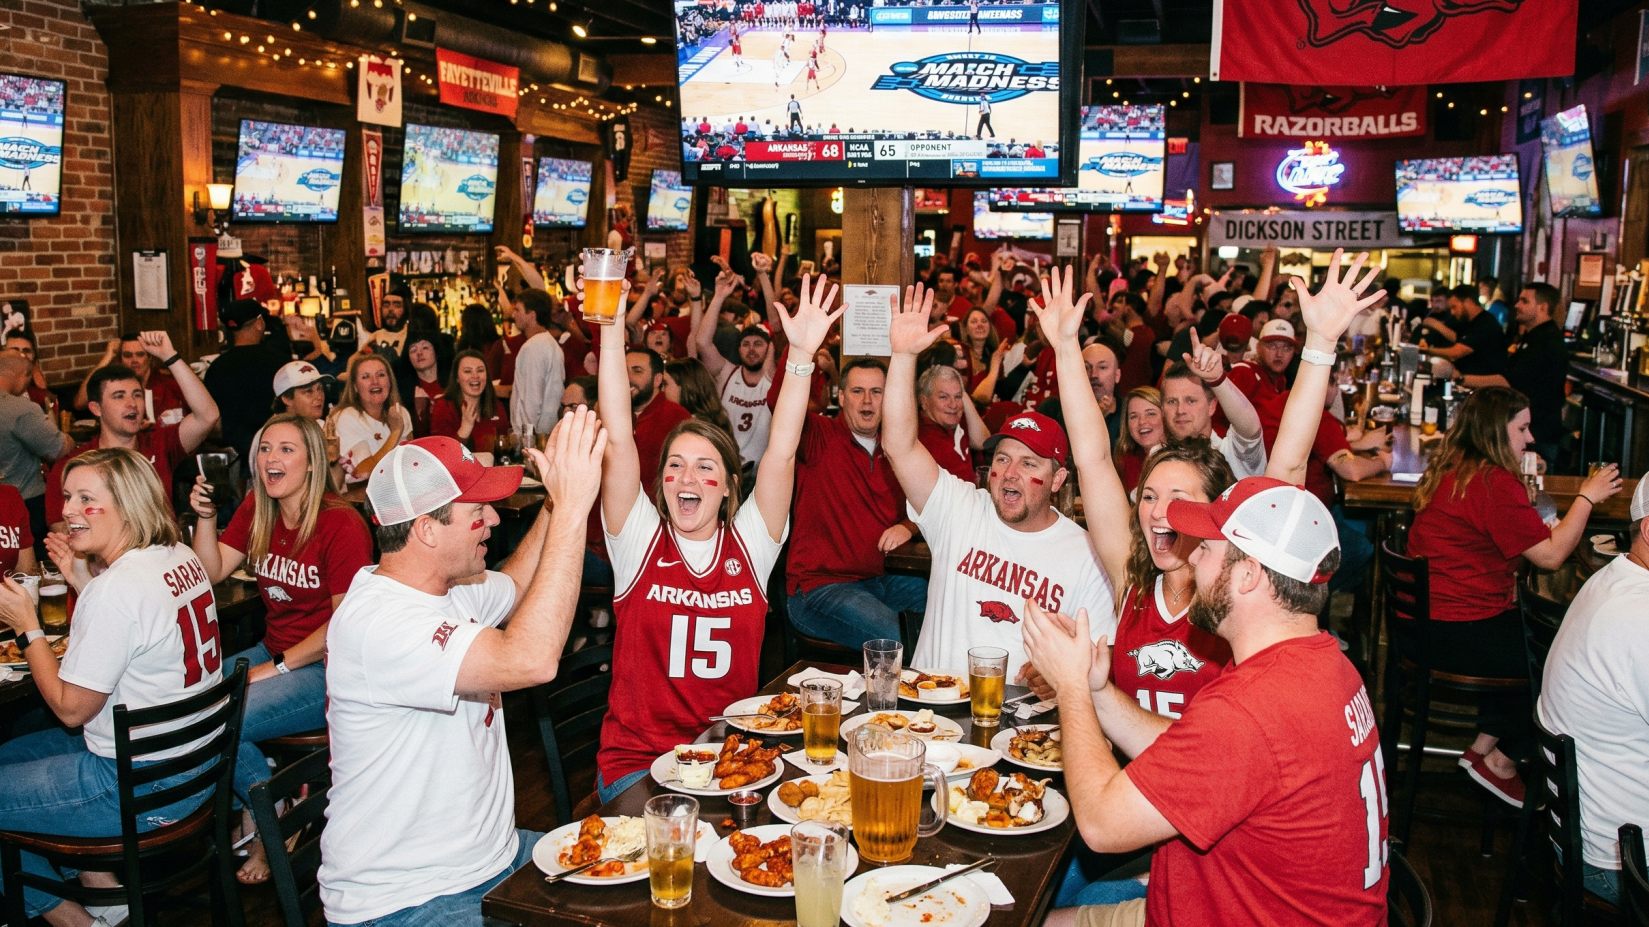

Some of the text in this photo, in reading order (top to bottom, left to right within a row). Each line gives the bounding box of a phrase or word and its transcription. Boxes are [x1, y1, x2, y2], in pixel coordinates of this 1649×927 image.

[440, 60, 517, 98] FAYETTEVILLE
[1253, 111, 1418, 137] RAZORBALLS
[767, 143, 808, 152] ARKANSAS
[821, 144, 839, 157] 68
[849, 143, 869, 151] NCAA
[879, 145, 896, 157] 65
[910, 143, 952, 151] OPPONENT
[1226, 220, 1385, 240] DICKSON STREET
[737, 412, 753, 431] 3
[956, 547, 1065, 614] ARKANSAS
[646, 584, 753, 609] ARKANSAS
[177, 589, 221, 689] 15
[668, 614, 732, 679] 15
